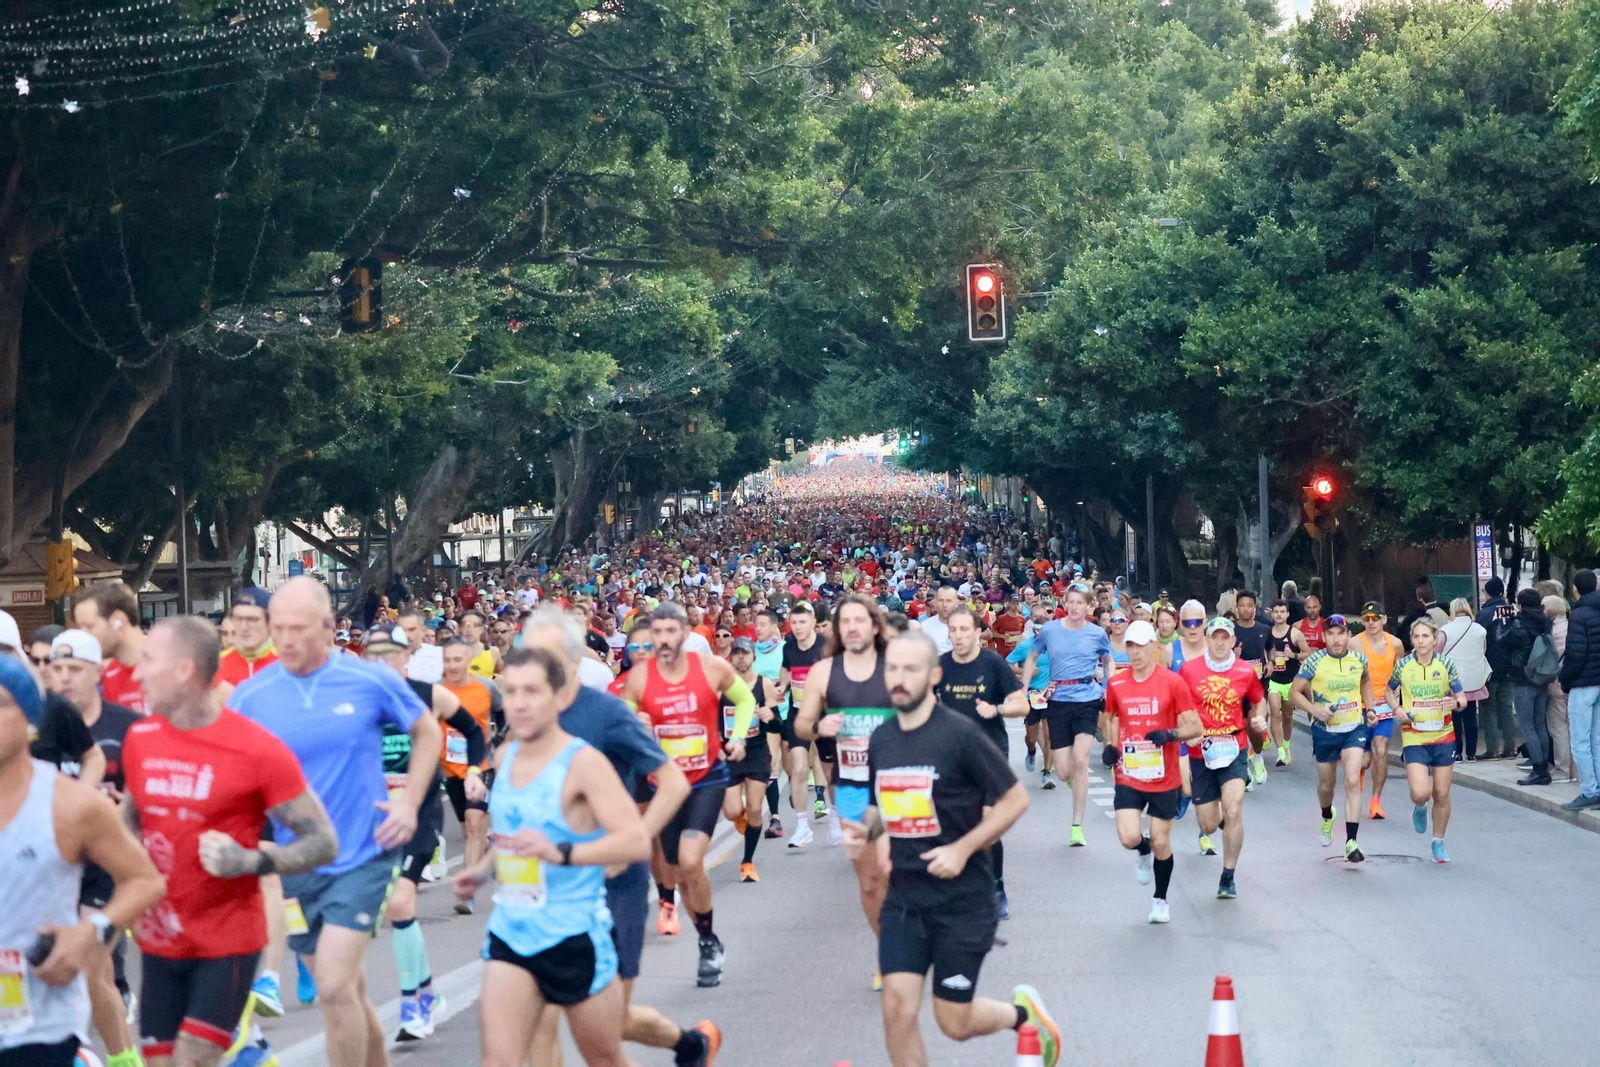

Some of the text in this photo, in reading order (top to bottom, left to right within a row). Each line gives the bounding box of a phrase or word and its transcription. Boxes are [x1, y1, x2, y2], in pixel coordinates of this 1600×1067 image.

[1476, 525, 1491, 536] BUS
[1480, 551, 1490, 559] 31
[1480, 560, 1491, 568] 23
[842, 715, 884, 728] EGAN
